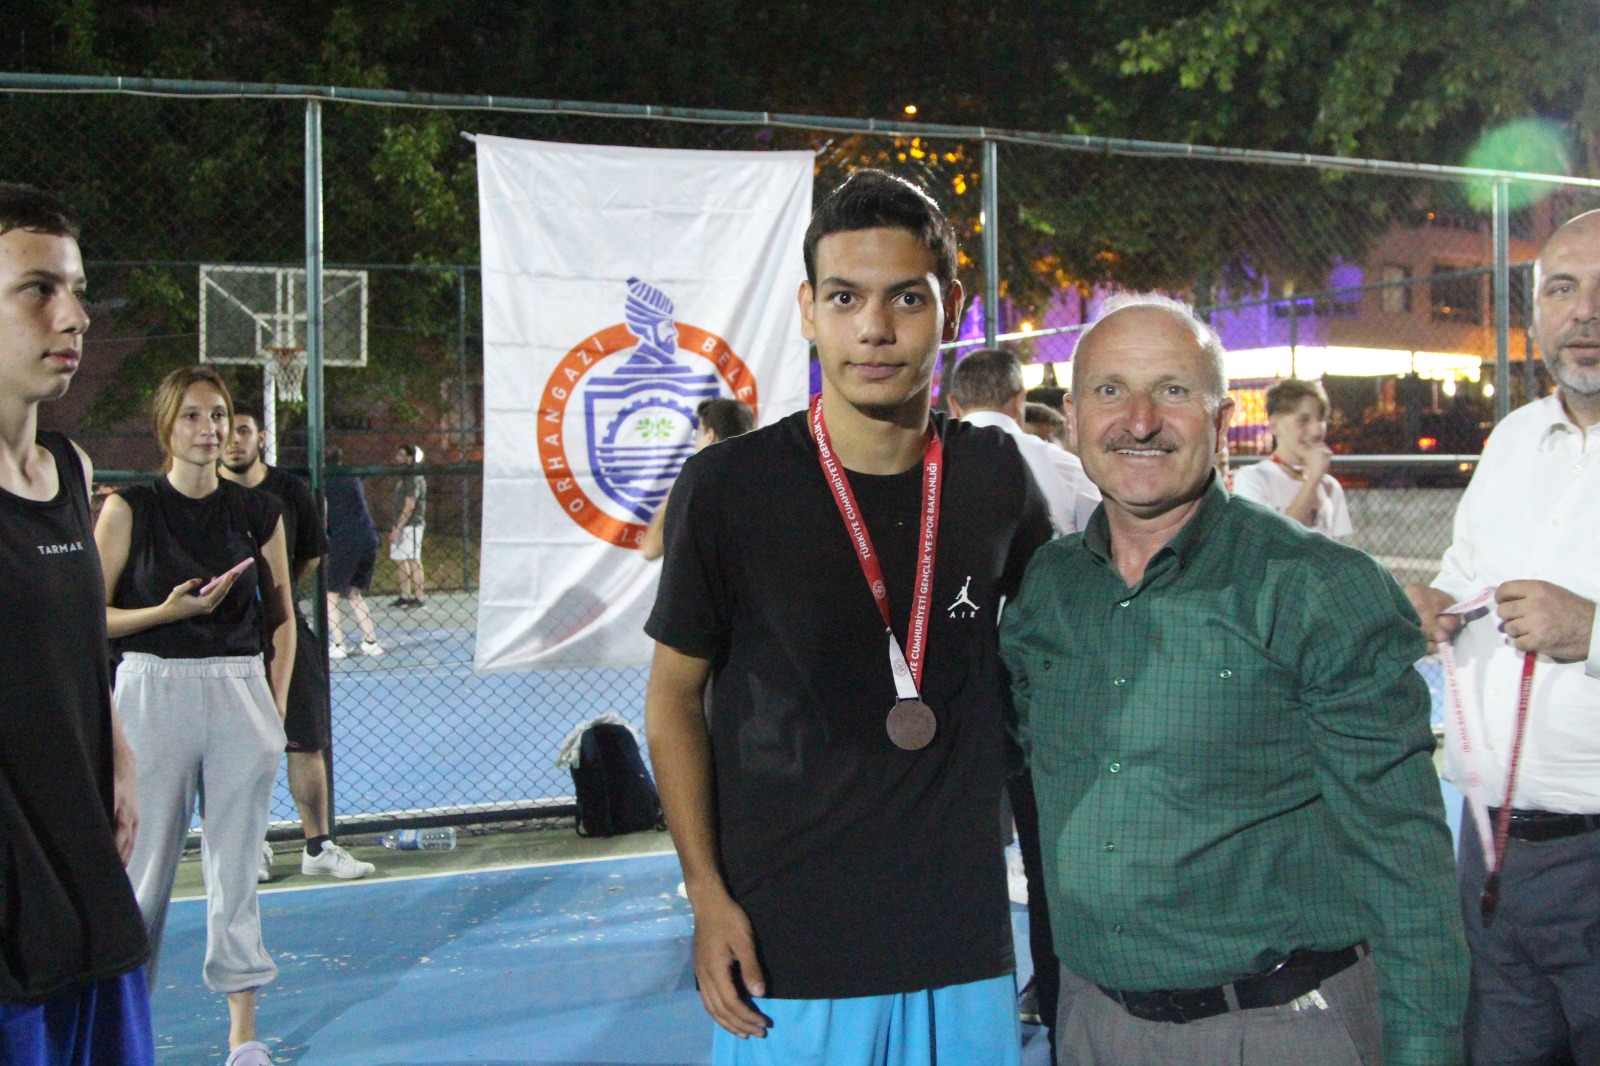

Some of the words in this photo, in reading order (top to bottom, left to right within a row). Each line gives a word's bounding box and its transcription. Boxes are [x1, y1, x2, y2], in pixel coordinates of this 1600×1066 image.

[823, 458, 856, 520] CUMHURİYETİ
[926, 462, 938, 514] BAKANLIĞI
[851, 520, 871, 560] TÜRKİYE
[924, 540, 933, 552] VE
[925, 515, 934, 539] SPOR
[920, 554, 932, 594] GENÇLİK
[911, 595, 927, 660] CUMHURİYETİ
[949, 611, 976, 619] AIR
